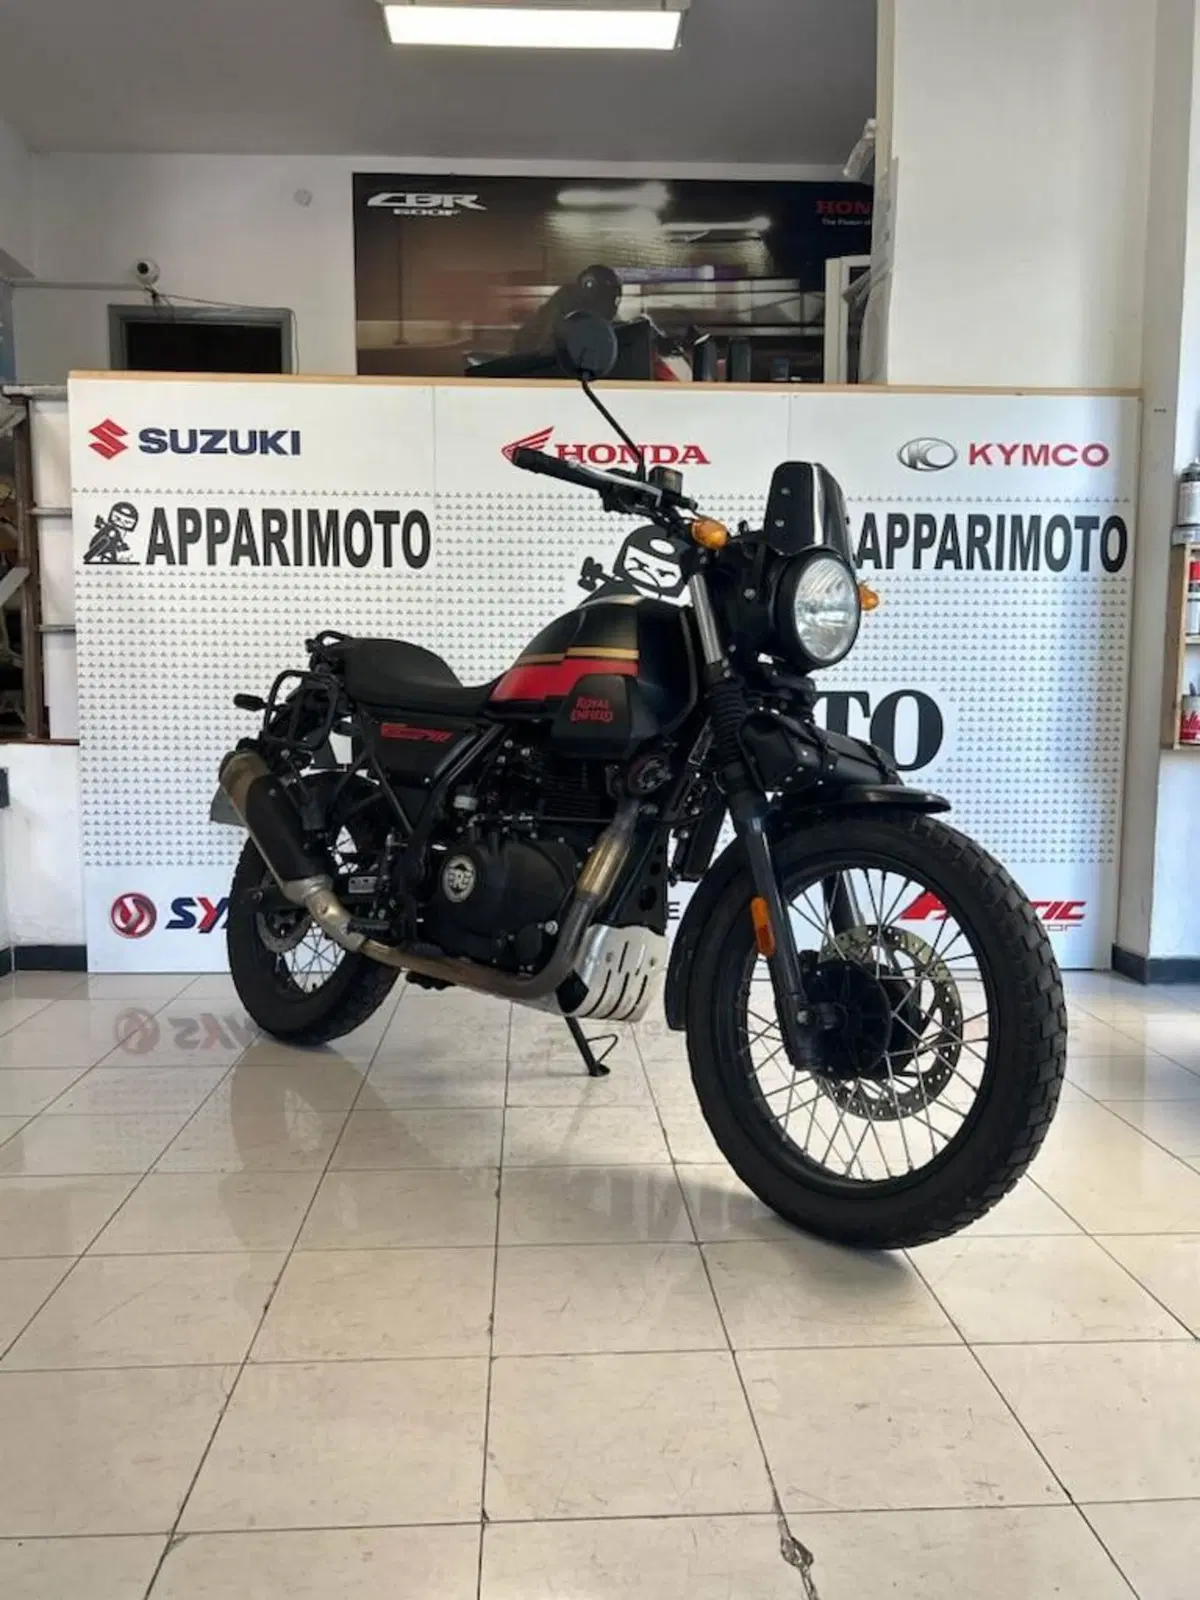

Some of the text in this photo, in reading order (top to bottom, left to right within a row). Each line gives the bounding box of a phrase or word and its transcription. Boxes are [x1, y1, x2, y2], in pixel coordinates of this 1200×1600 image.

[367, 192, 487, 210] CBR
[815, 200, 873, 214] HON
[138, 428, 301, 455] SUZUKI
[554, 444, 710, 465] HONDA
[969, 442, 1109, 467] KYMCO
[146, 506, 431, 569] APPARIMOTO
[855, 512, 1128, 573] APPARIMOTO
[815, 689, 944, 772] TO
[165, 896, 230, 934] SY
